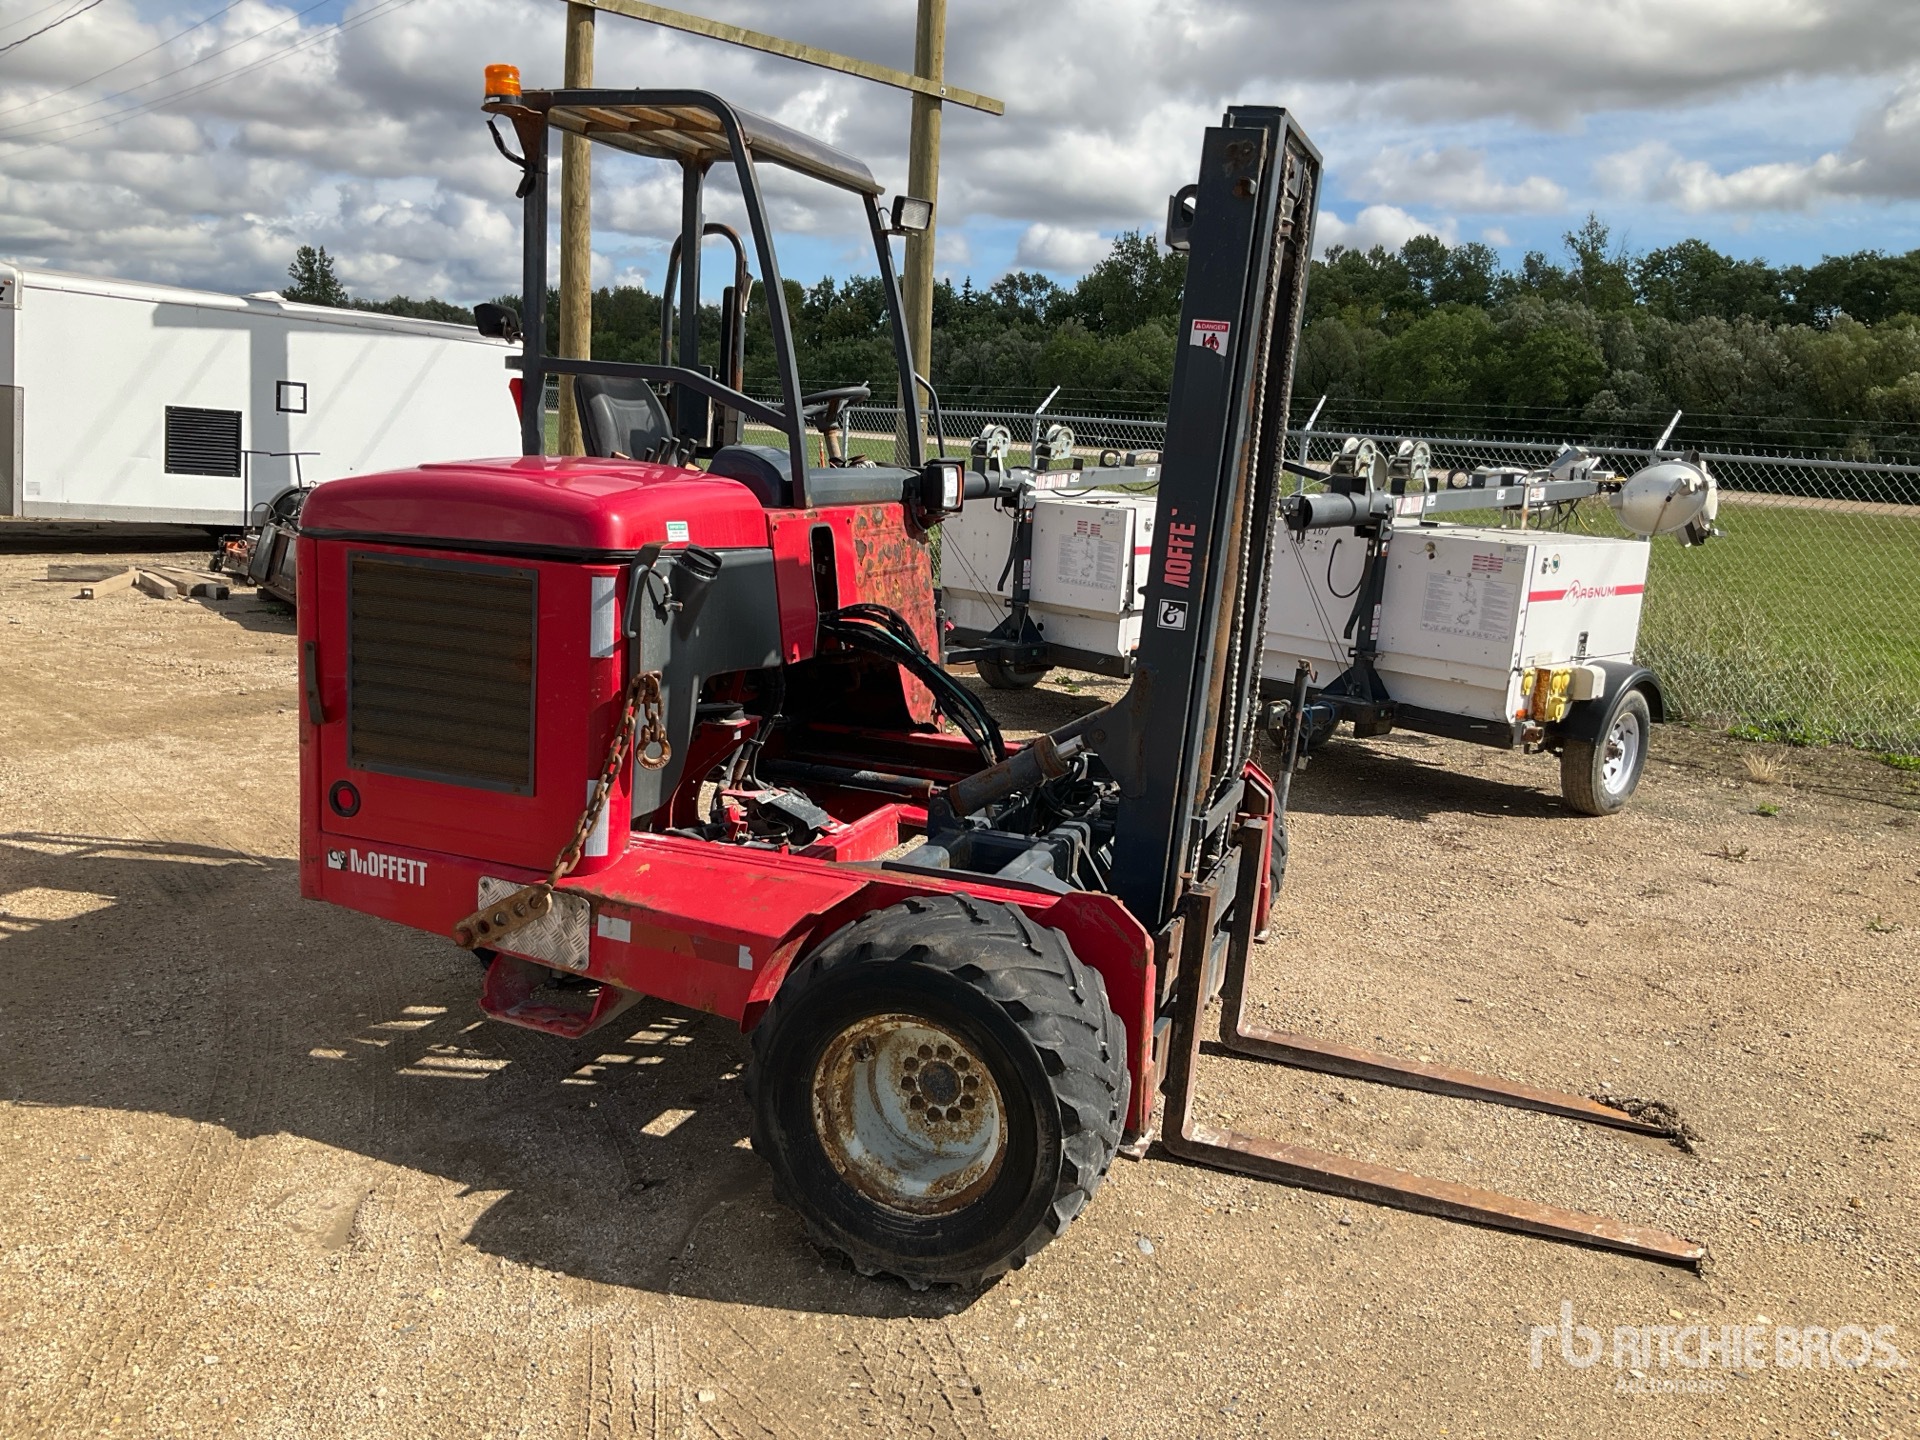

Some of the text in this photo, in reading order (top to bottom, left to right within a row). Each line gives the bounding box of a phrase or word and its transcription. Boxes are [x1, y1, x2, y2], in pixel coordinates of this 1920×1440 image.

[1201, 322, 1227, 332] DANGER
[1566, 580, 1616, 604] MAGNUM
[349, 848, 428, 887] MOFFETT
